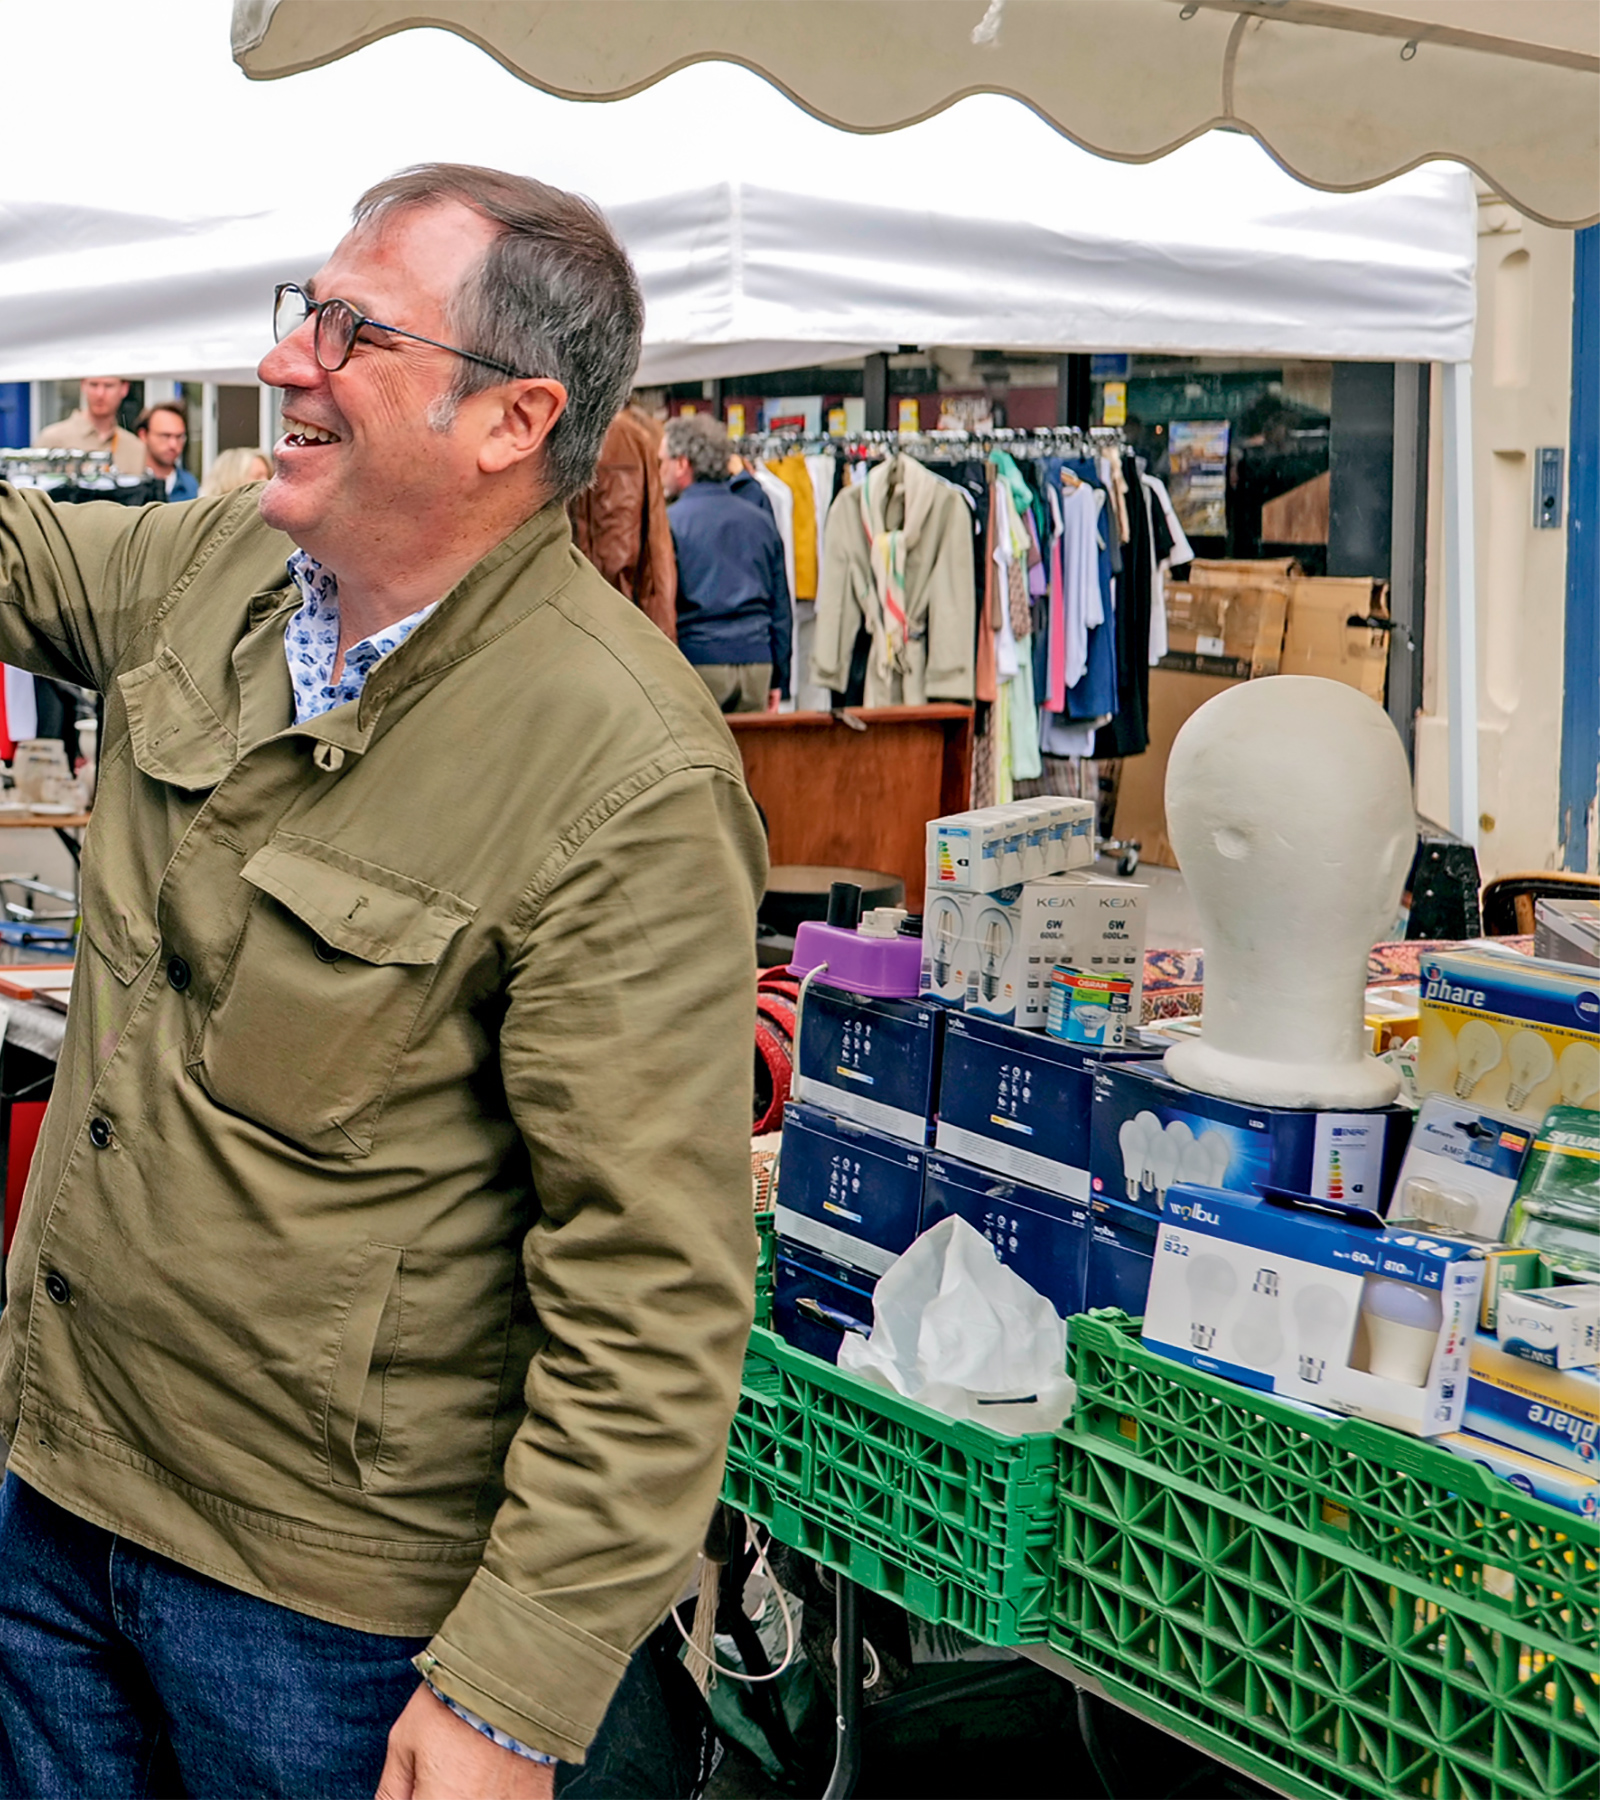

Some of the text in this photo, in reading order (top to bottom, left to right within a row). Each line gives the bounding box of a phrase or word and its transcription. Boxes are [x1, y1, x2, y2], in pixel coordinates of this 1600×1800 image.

[1037, 897, 1075, 908] KEJA
[1099, 897, 1137, 908] KEJA
[1046, 919, 1064, 930] 6W
[1108, 919, 1126, 931] 6W
[1077, 979, 1109, 990] OSRAM
[1425, 978, 1486, 1008] phare
[1168, 1202, 1221, 1226] wolbu
[1163, 1240, 1190, 1257] B22
[1505, 1314, 1554, 1334] KEJA
[1527, 1406, 1599, 1443] phare
